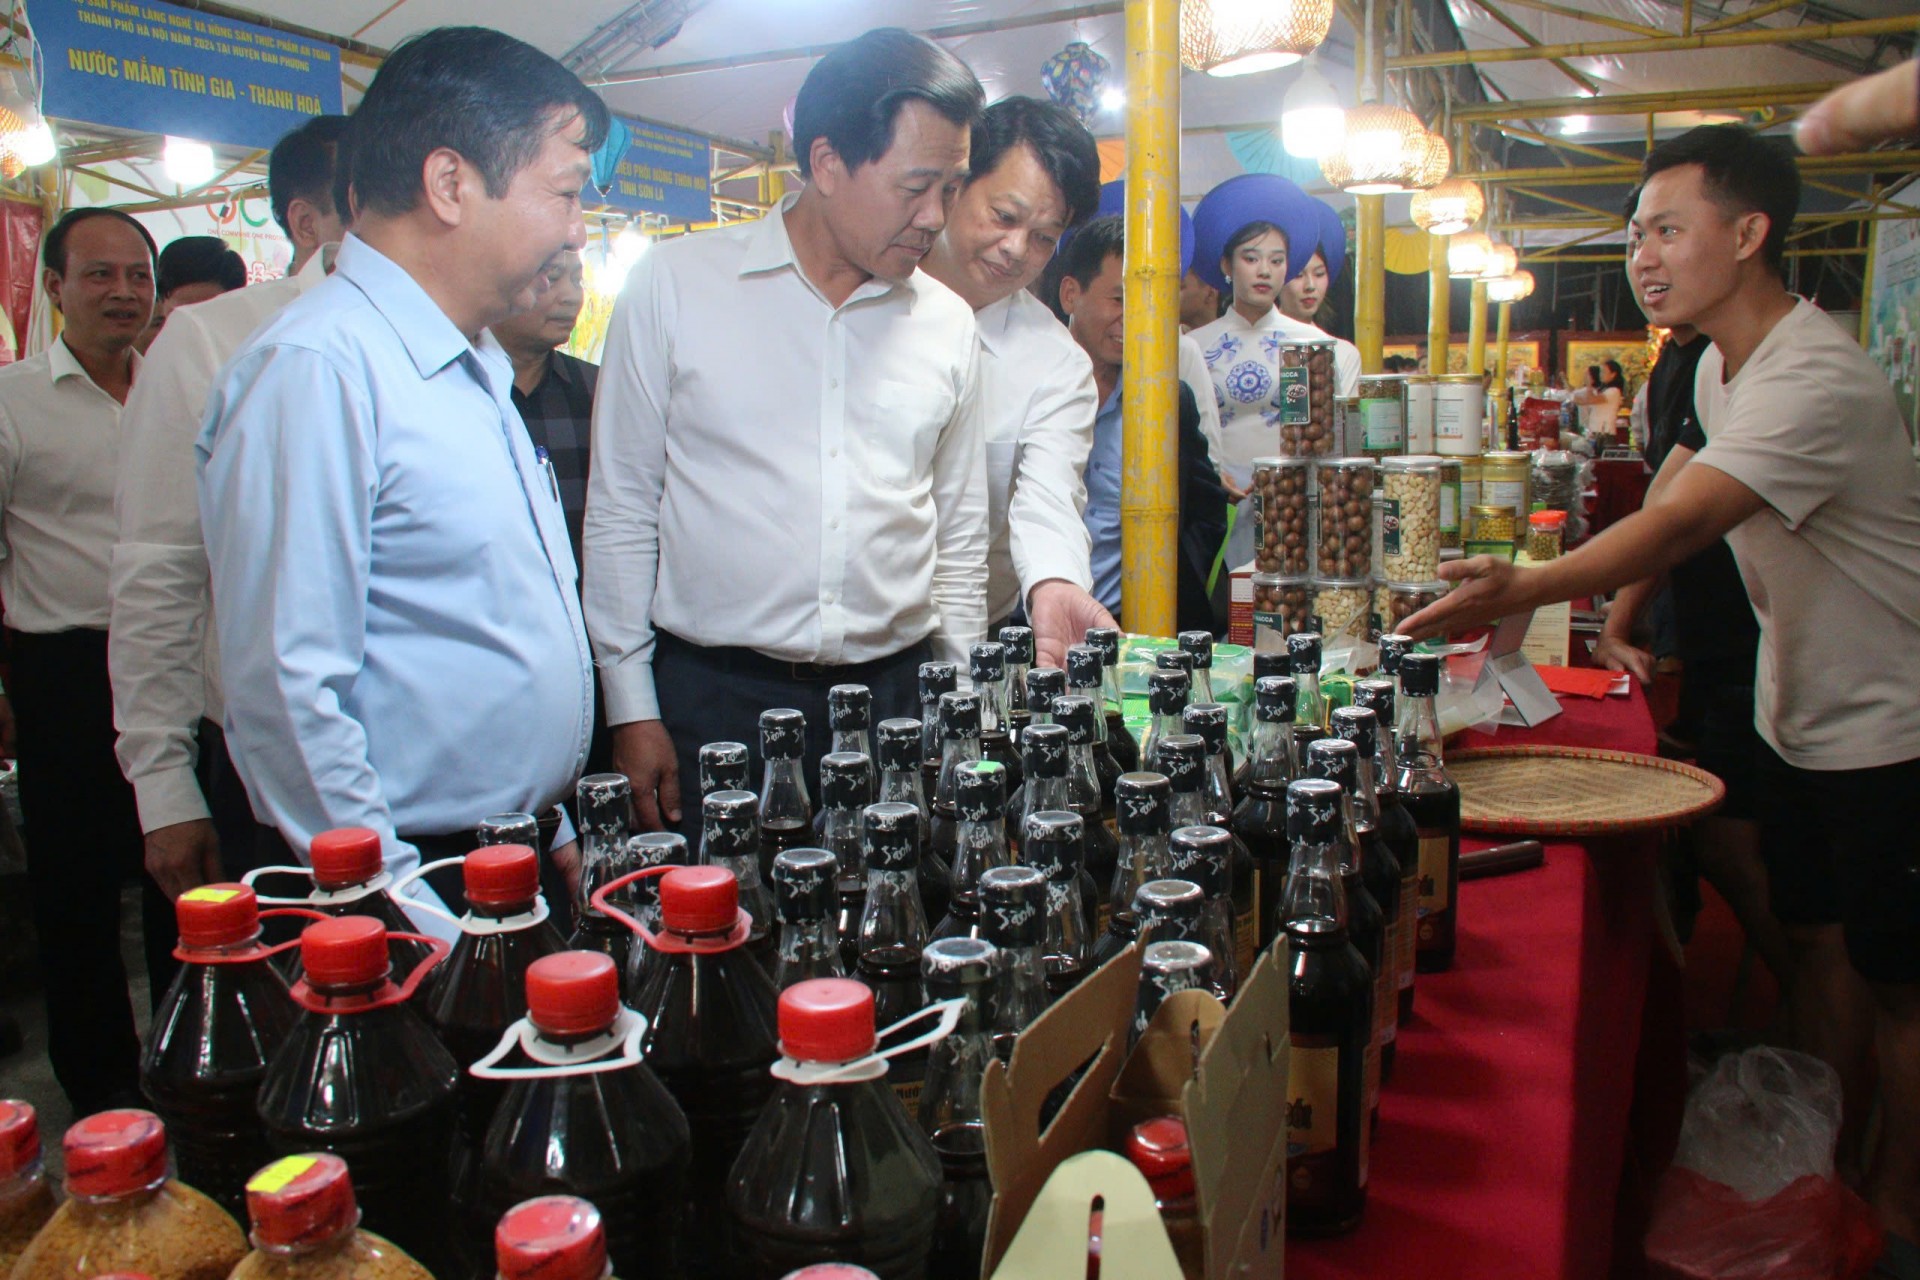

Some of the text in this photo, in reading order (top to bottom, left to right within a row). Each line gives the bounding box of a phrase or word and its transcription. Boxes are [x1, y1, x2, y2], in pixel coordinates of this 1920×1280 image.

[78, 9, 112, 29] THÀNH
[114, 17, 134, 34] PHỐ
[152, 27, 168, 42] NỘI
[170, 31, 191, 47] NĂM
[68, 47, 119, 78] NƯỚC
[123, 56, 166, 88] MẮM
[169, 66, 206, 96] TĨNH
[209, 76, 236, 101] GIA
[248, 83, 294, 111] THANH
